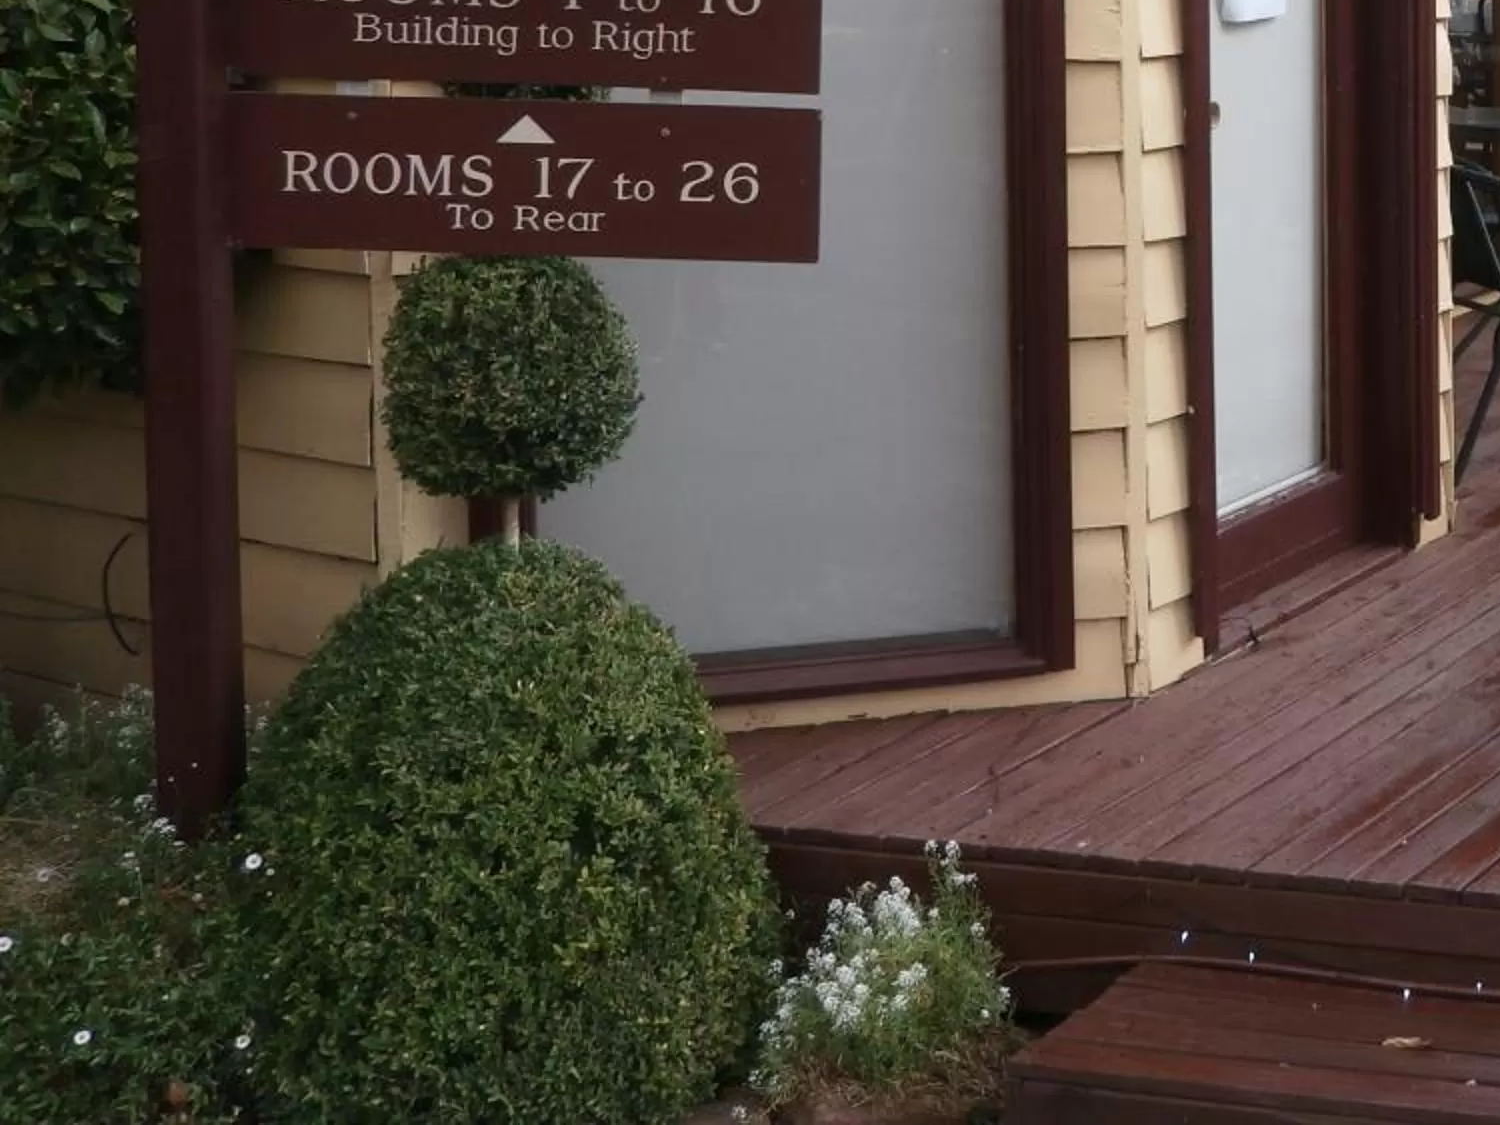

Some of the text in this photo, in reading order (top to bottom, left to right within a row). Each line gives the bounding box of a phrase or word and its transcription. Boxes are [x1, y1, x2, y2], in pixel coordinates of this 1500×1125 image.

[353, 13, 697, 60] Building to Right
[282, 150, 761, 205] ROOMS 17 to 26
[445, 203, 607, 233] To Rear
